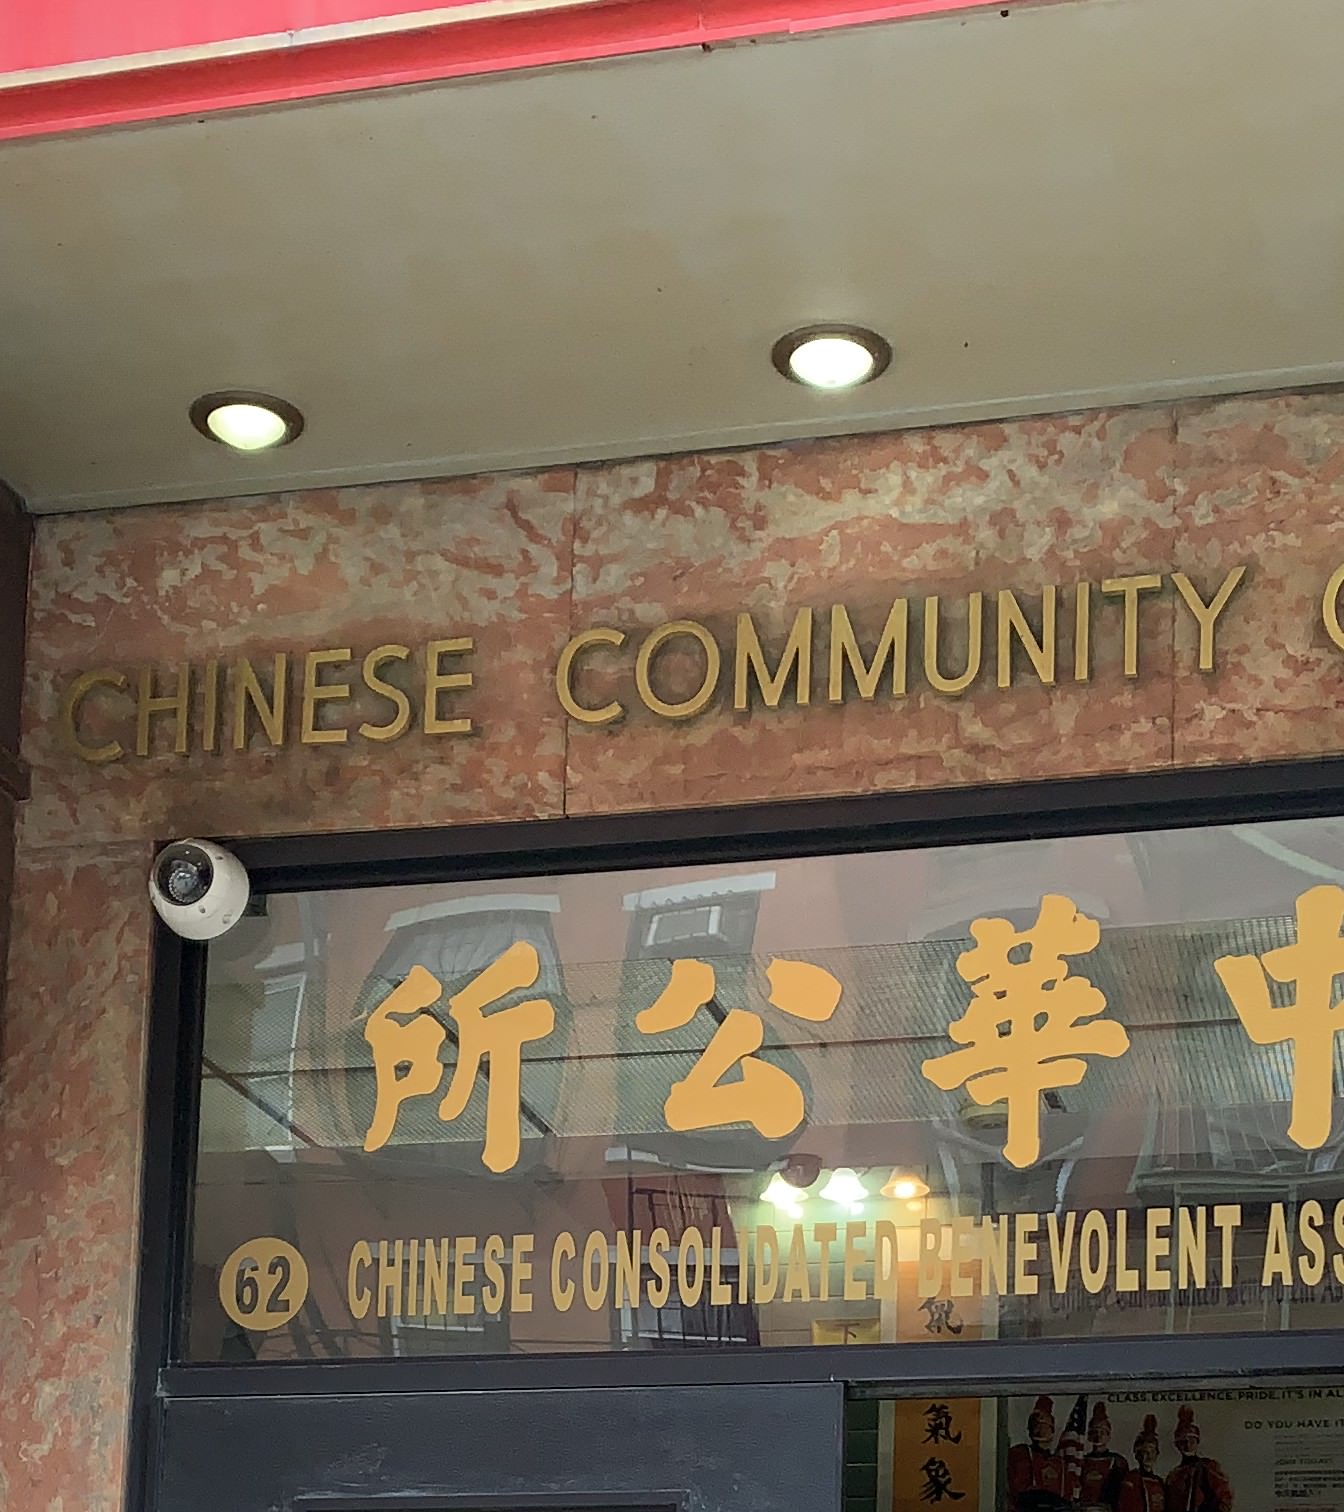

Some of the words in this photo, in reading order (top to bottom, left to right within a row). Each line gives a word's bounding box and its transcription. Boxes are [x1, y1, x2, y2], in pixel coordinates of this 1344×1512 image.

[69, 637, 475, 763] CHINESE
[556, 565, 1246, 724] COMMUNITY
[235, 1254, 292, 1316] 62
[348, 1232, 534, 1319] CHINESE
[552, 1218, 899, 1312] CONSOLIDATED
[918, 1204, 1241, 1298] BENEVOLENT
[1244, 1420, 1263, 1429] DO
[1267, 1420, 1293, 1429] YOU
[1297, 1419, 1330, 1428] HAVE
[1308, 1389, 1322, 1398] IN
